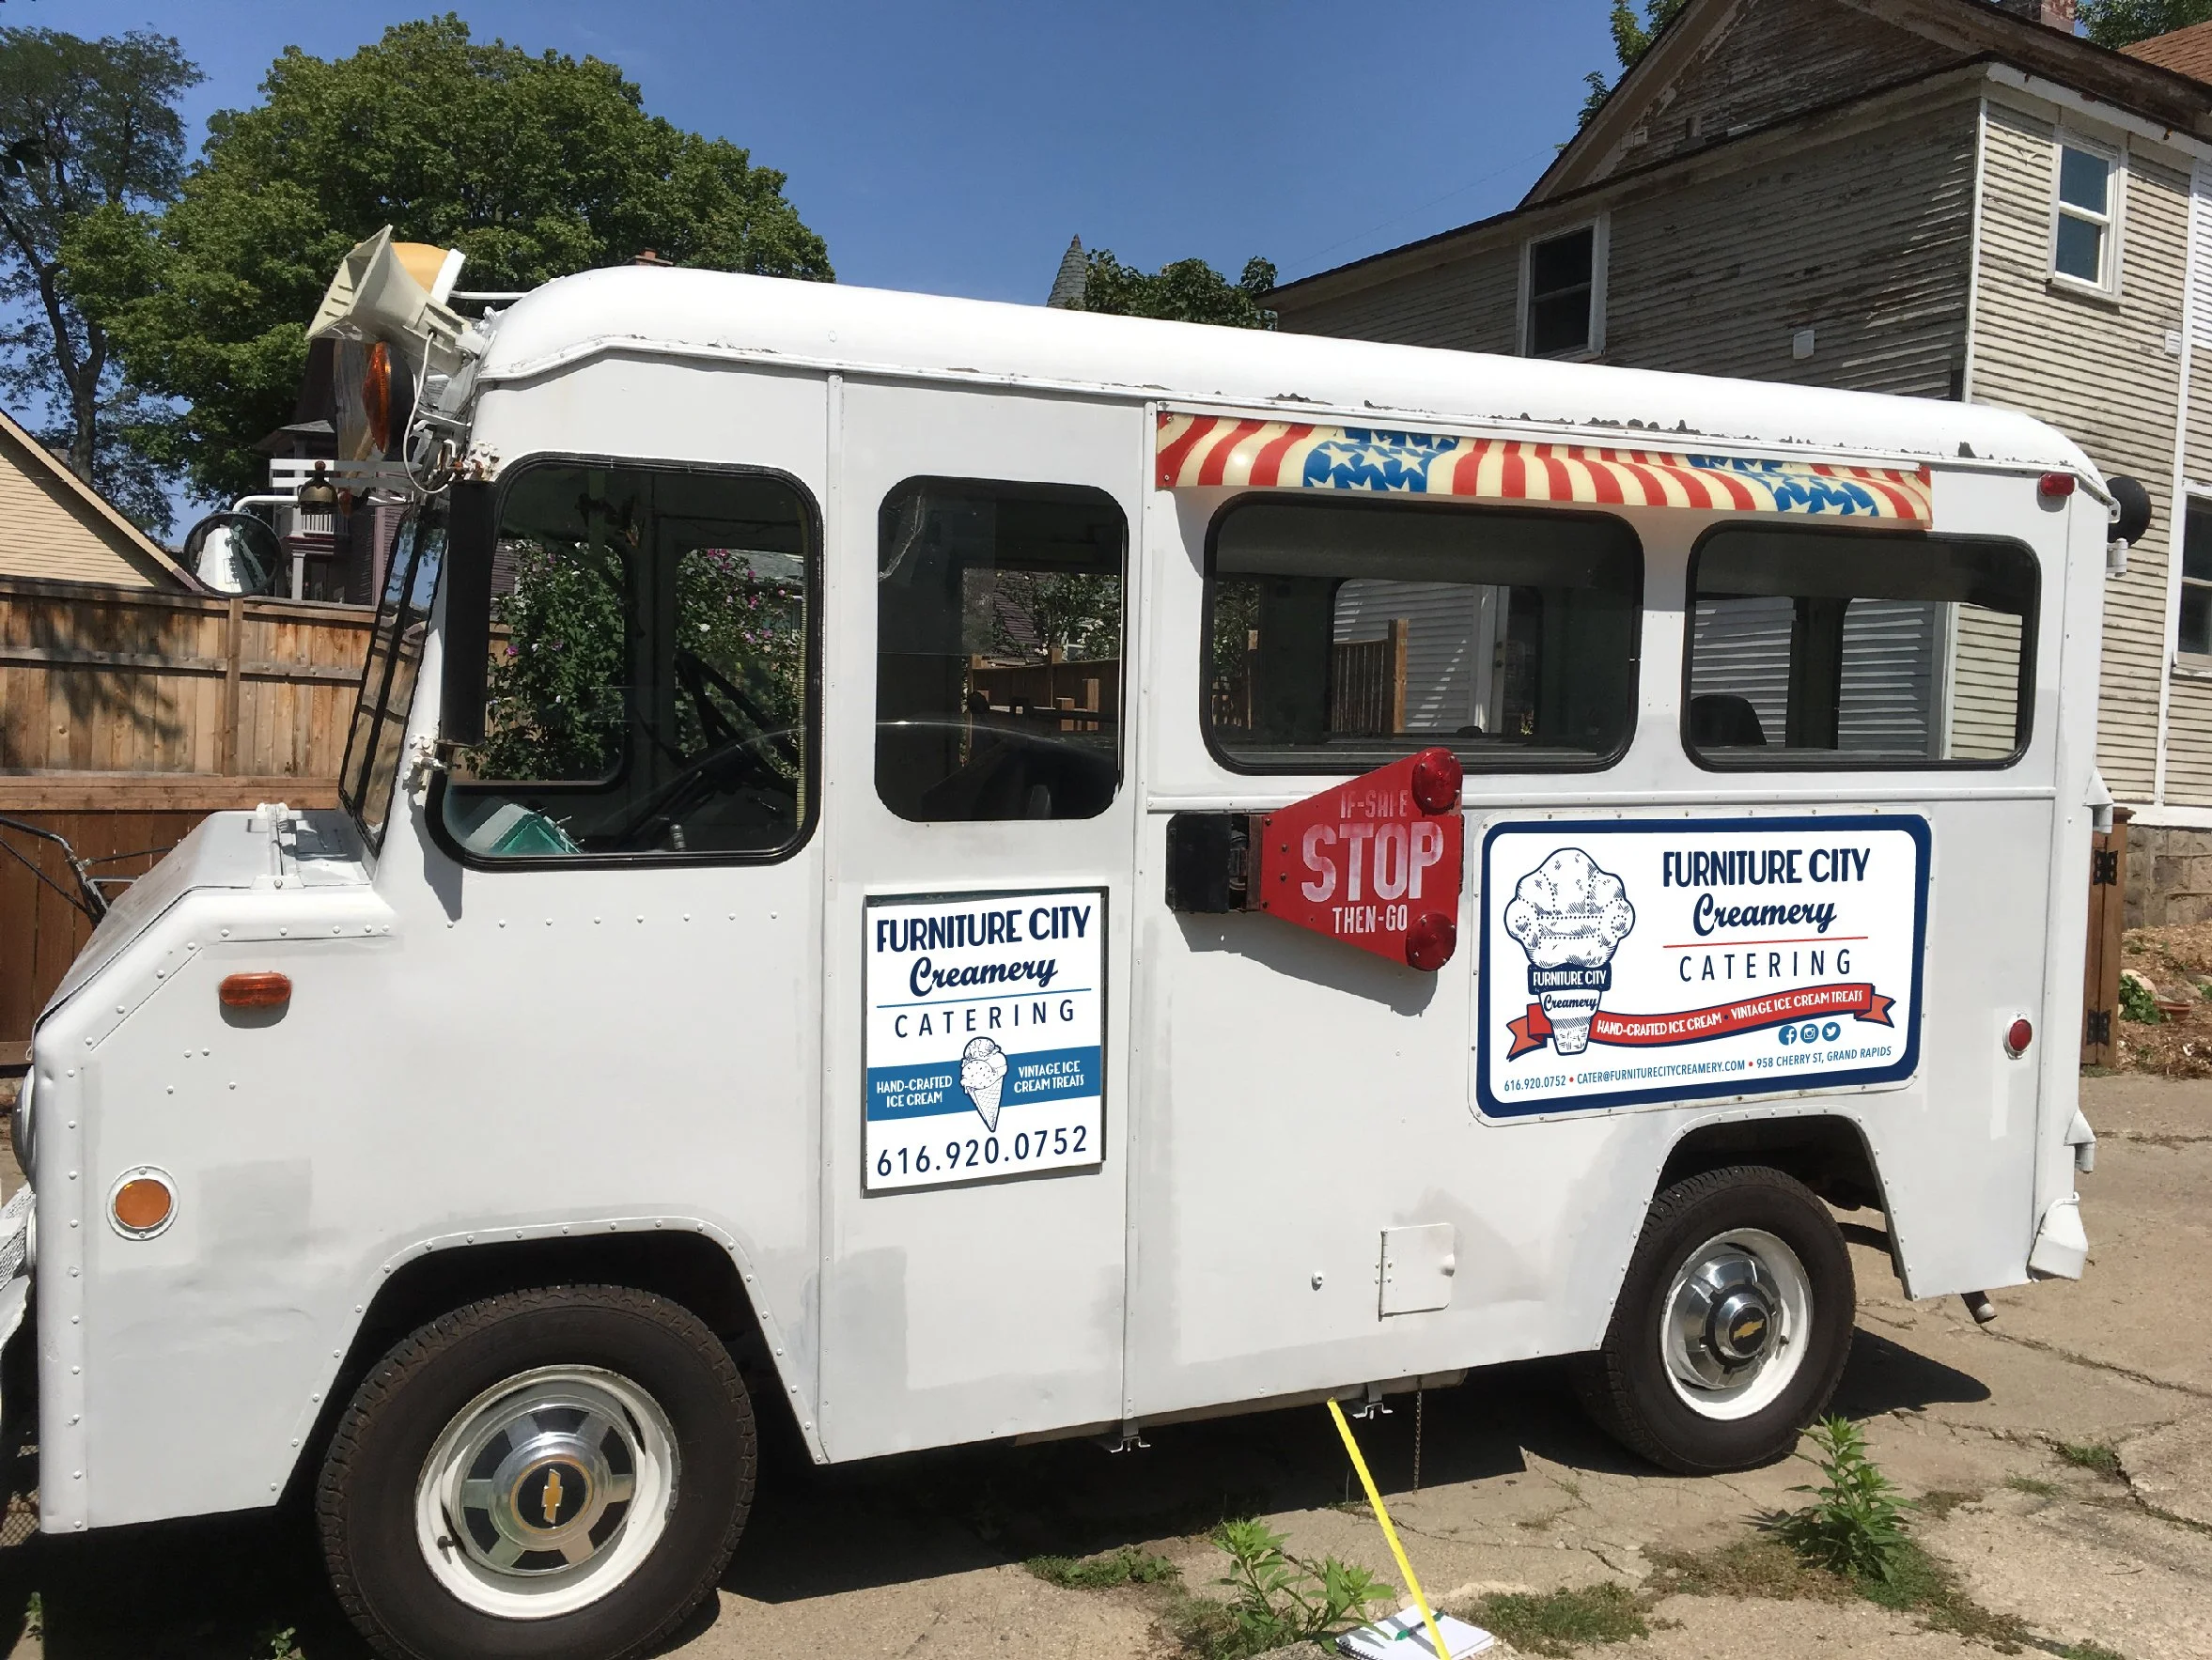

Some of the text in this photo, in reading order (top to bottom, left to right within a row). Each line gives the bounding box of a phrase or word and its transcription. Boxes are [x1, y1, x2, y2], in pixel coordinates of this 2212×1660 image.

[1340, 790, 1409, 819] IF-SAFE
[1301, 821, 1444, 903] STOP
[1662, 848, 1871, 887] FURNITURE CITY
[876, 906, 1092, 954] FURNITURE CITY
[1332, 904, 1408, 934] THEN-GO
[1692, 892, 1837, 937] Creamery
[909, 956, 1059, 997] Creamery
[1533, 970, 1607, 986] FURNITURE CITY
[1679, 949, 1850, 982] CATERING
[895, 999, 1074, 1038] CATERING
[1543, 994, 1598, 1012] Creamery
[1597, 989, 1863, 1036] HAND-CRAFTED ICE CREAM VINTAGE ICE CREAM TREATS
[876, 1075, 953, 1094] HAND-CRAFTED
[1014, 1074, 1085, 1094] CREAM TREATS
[1018, 1060, 1081, 1078] VINTAGE ICE
[1503, 1046, 1893, 1092] 616.920.0752 CATER@FURNITURECITYCREAMERY.COM 958 CHERRY ST, GRAND RAPIDS
[886, 1091, 942, 1109] ICE CREAM
[876, 1125, 1087, 1177] 616.920.0752
